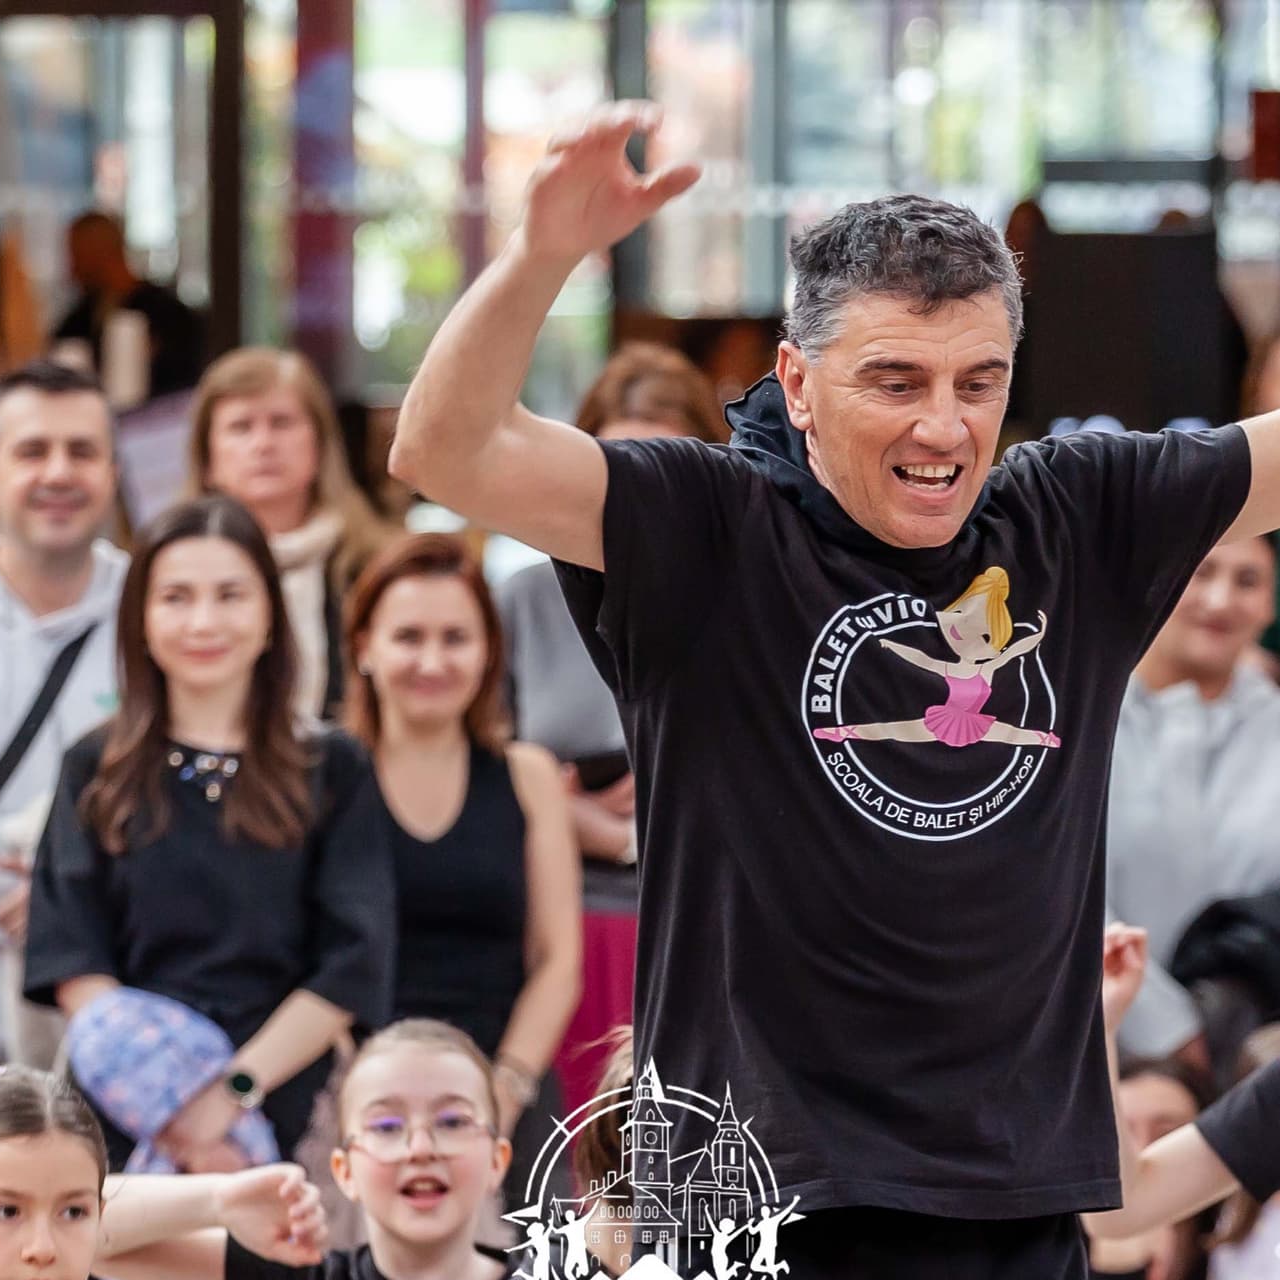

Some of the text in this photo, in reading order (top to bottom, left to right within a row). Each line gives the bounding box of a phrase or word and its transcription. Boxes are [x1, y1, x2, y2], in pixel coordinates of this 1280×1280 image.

[884, 801, 910, 824] DE
[913, 810, 967, 829] BALET
[985, 754, 1036, 814] HIP-HOP
